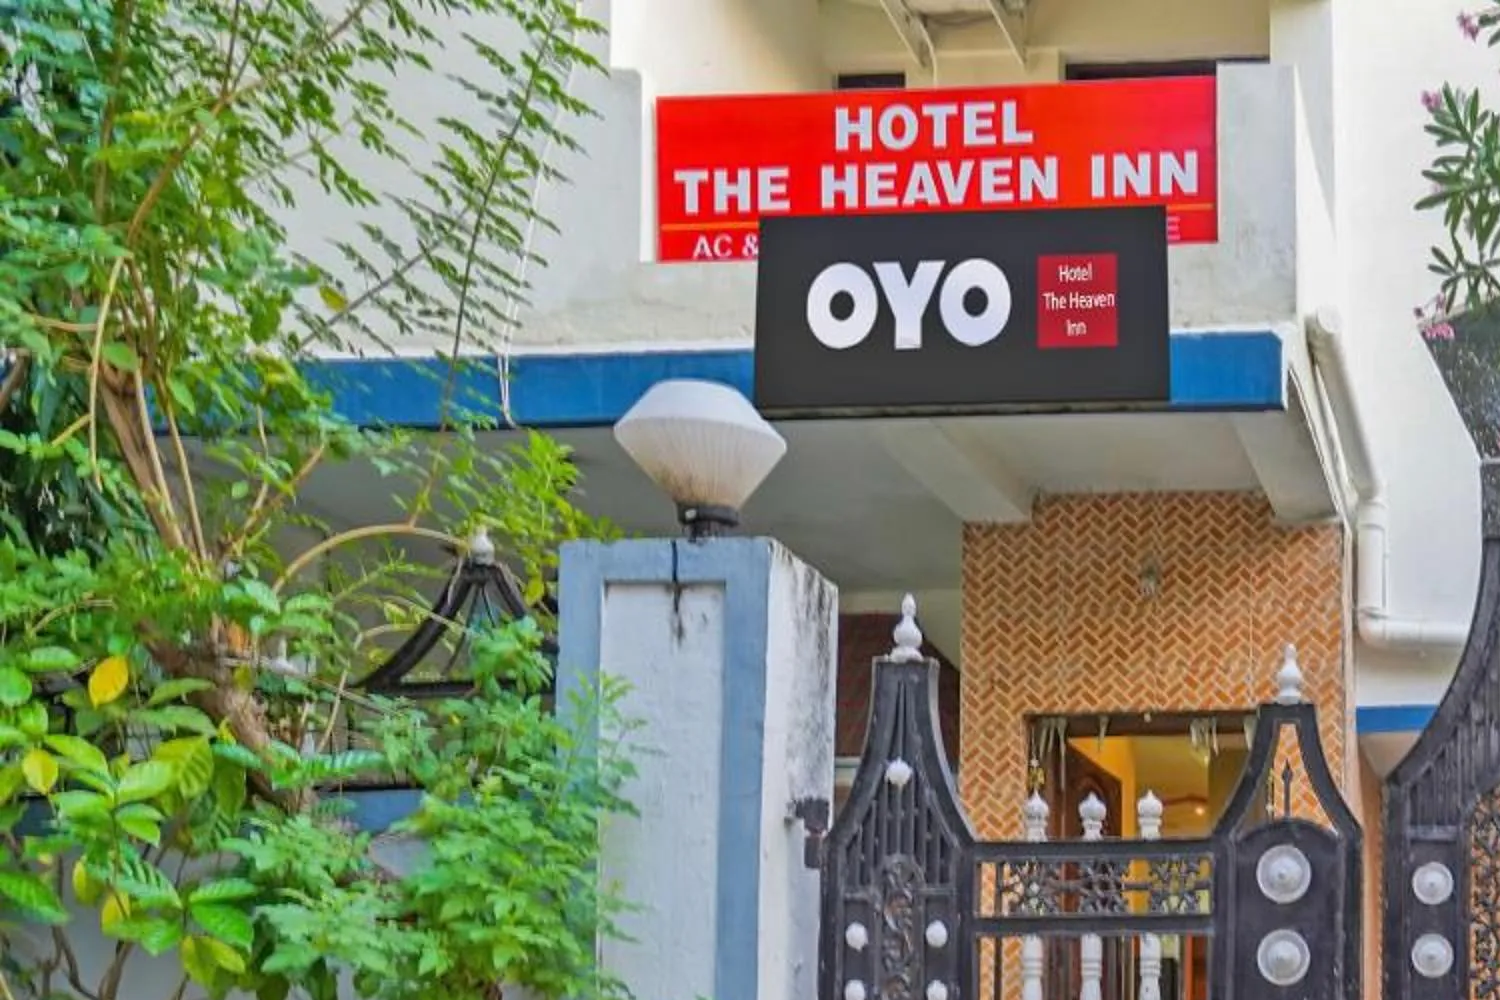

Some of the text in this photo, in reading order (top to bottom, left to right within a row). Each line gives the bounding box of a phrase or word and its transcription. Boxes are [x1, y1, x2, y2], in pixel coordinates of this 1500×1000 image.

[834, 101, 1034, 152] HOTEL
[674, 150, 1199, 215] THE HEAVEN INN
[693, 232, 733, 260] AC
[1058, 262, 1093, 283] Hotel
[806, 257, 1011, 350] OYO
[1042, 291, 1116, 311] The Heaven
[1066, 319, 1087, 337] Inn
